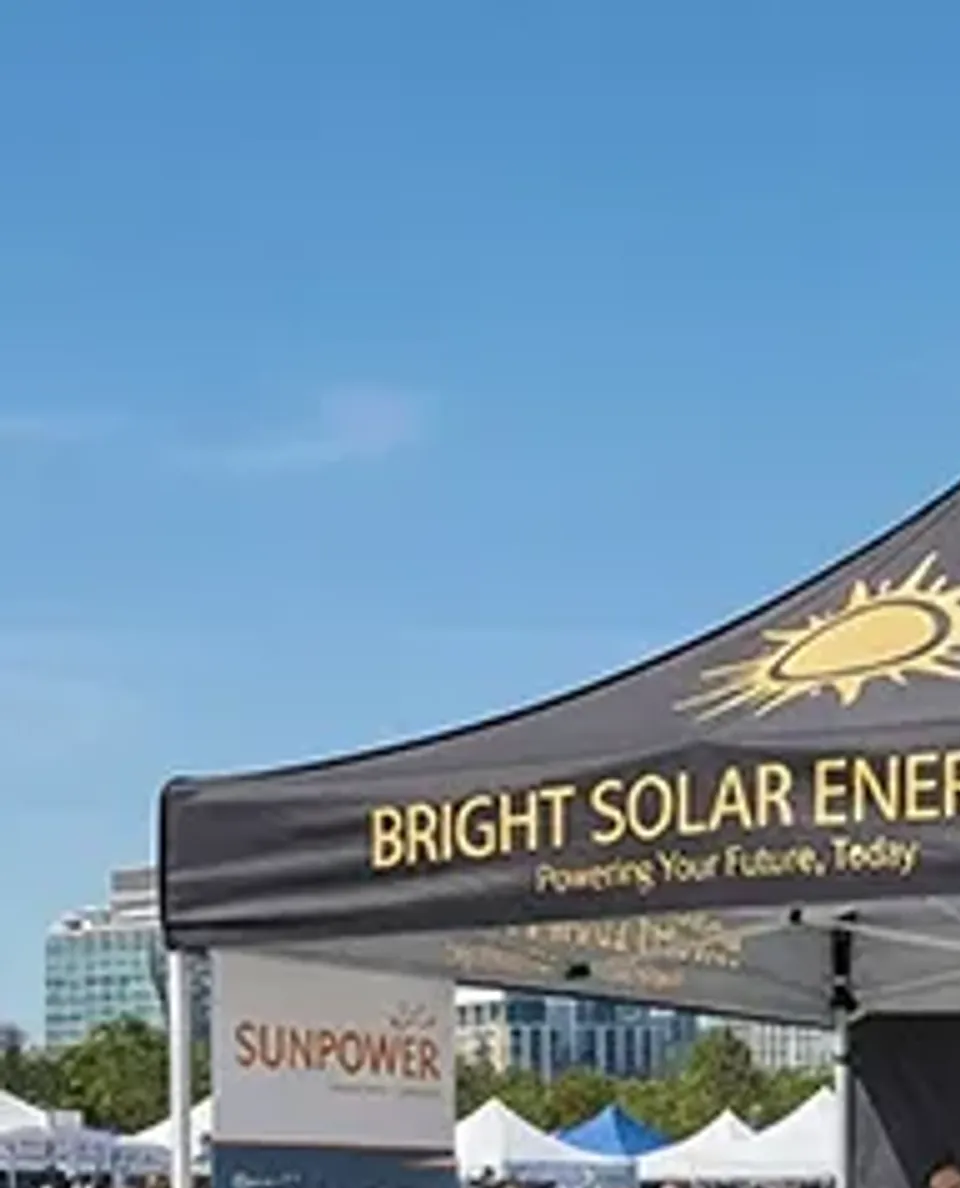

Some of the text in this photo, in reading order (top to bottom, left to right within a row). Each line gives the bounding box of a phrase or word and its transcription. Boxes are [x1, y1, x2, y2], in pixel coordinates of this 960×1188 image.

[371, 784, 577, 870] BRIGHT
[589, 762, 795, 844] SOLAR
[534, 834, 922, 896] Powering Your Future, Today
[233, 1019, 443, 1082] SUNPOWER
